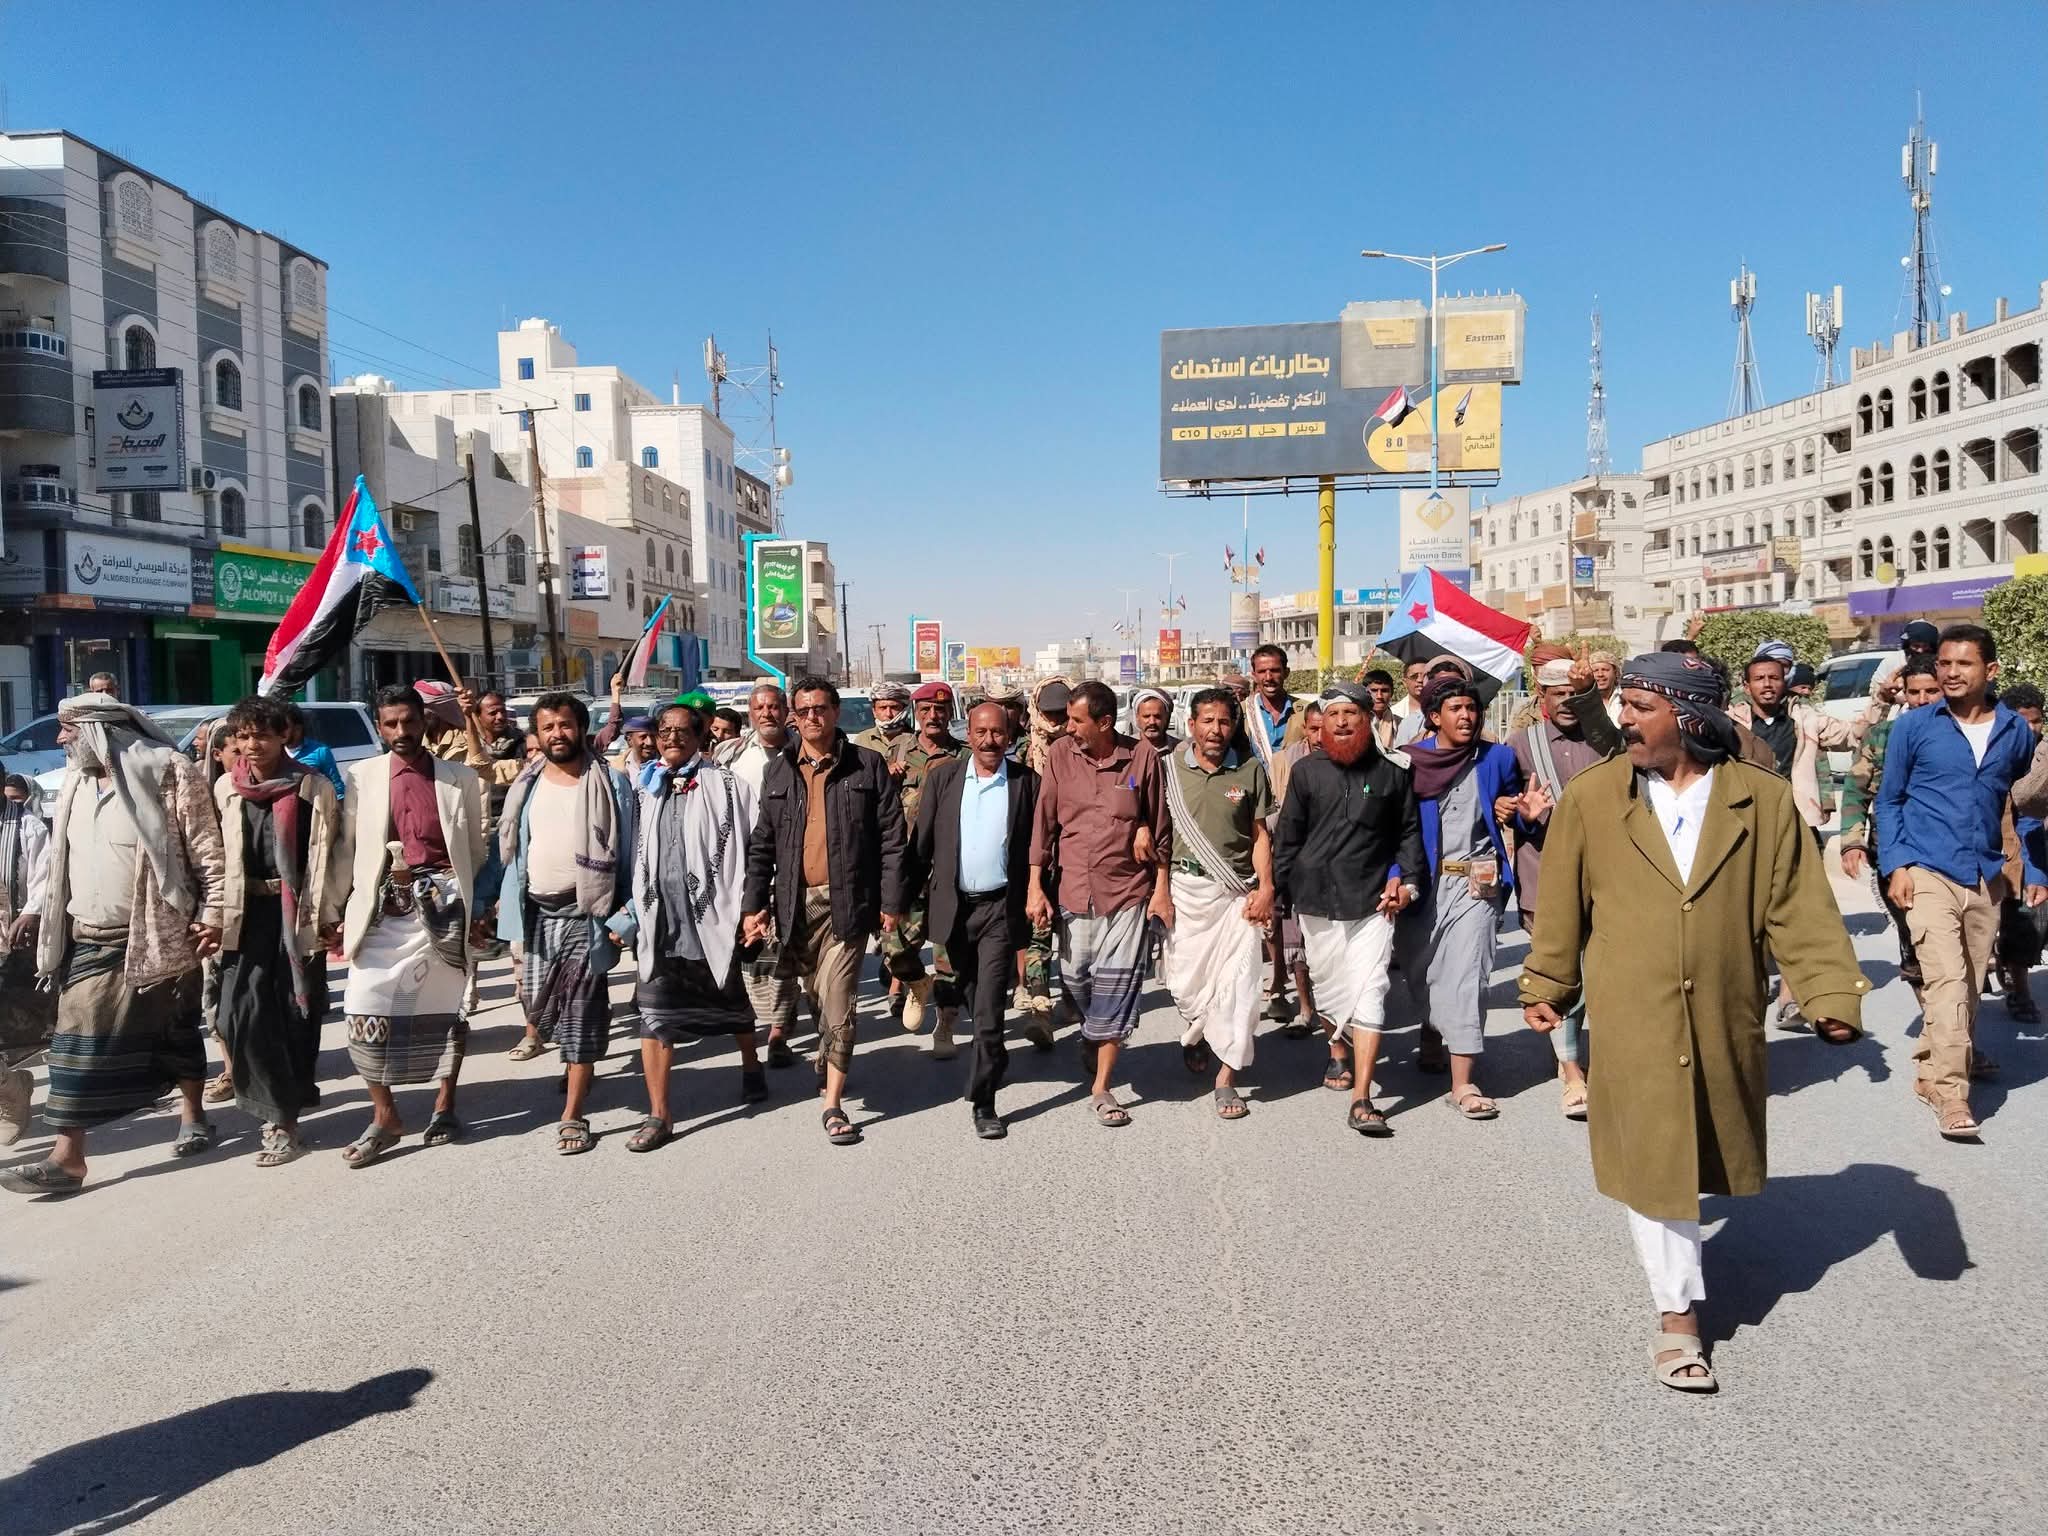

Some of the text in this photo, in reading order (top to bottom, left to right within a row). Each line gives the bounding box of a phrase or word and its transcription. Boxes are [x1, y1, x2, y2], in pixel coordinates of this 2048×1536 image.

[1465, 333, 1506, 343] Eastman
[1170, 353, 1330, 380] بطاريات استمان
[1171, 397, 1213, 413] العملاء
[1214, 395, 1237, 411] لدى
[1291, 389, 1326, 411] الأكثر
[1179, 430, 1201, 439] C10
[1465, 432, 1496, 443] الرقم
[1464, 442, 1495, 453] المجاني
[102, 554, 132, 569] للصرافة
[1408, 551, 1463, 560] Alinma Bank
[133, 560, 168, 575] المريسي
[167, 561, 188, 577] شركة
[102, 574, 131, 584] ALMORISI
[131, 576, 162, 587] EXCHANGE
